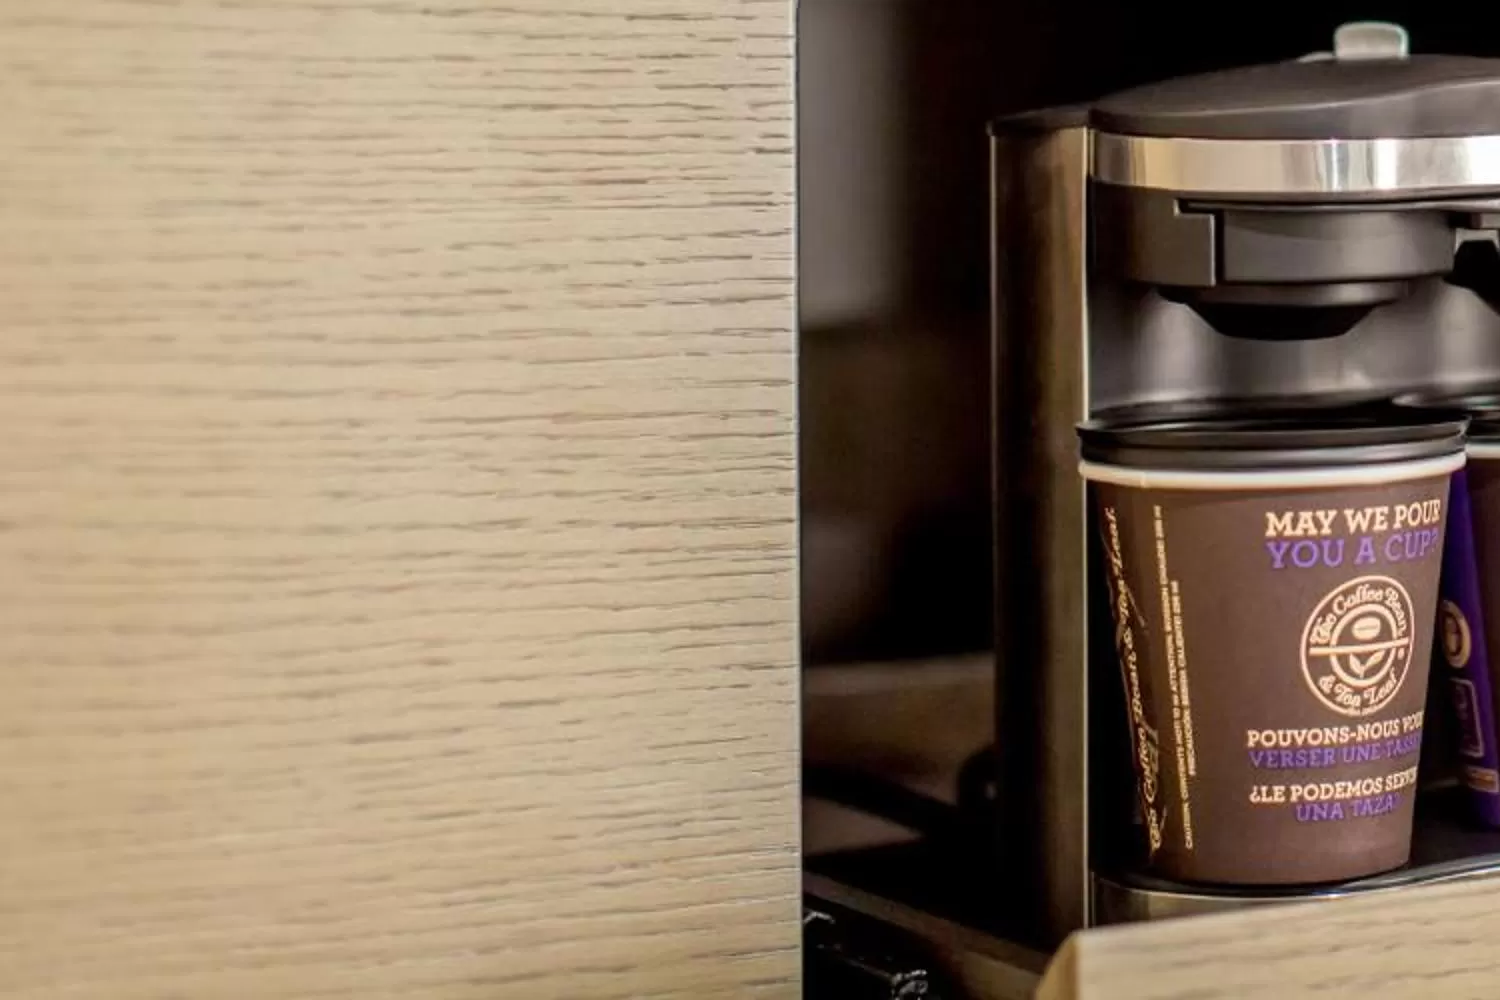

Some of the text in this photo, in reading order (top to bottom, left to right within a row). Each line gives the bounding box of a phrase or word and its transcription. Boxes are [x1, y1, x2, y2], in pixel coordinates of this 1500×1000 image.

[1264, 499, 1441, 538] MAY WE POUR
[1265, 527, 1438, 569] YOU A CUP?
[1332, 583, 1385, 616] Coffee
[1247, 717, 1400, 748] POUVONS-NOUS
[1249, 748, 1336, 769] VERSER
[1341, 742, 1382, 763] UNE
[1249, 784, 1287, 804] ¿LE
[1290, 776, 1384, 802] PODEMOS
[1296, 802, 1345, 823] UNA
